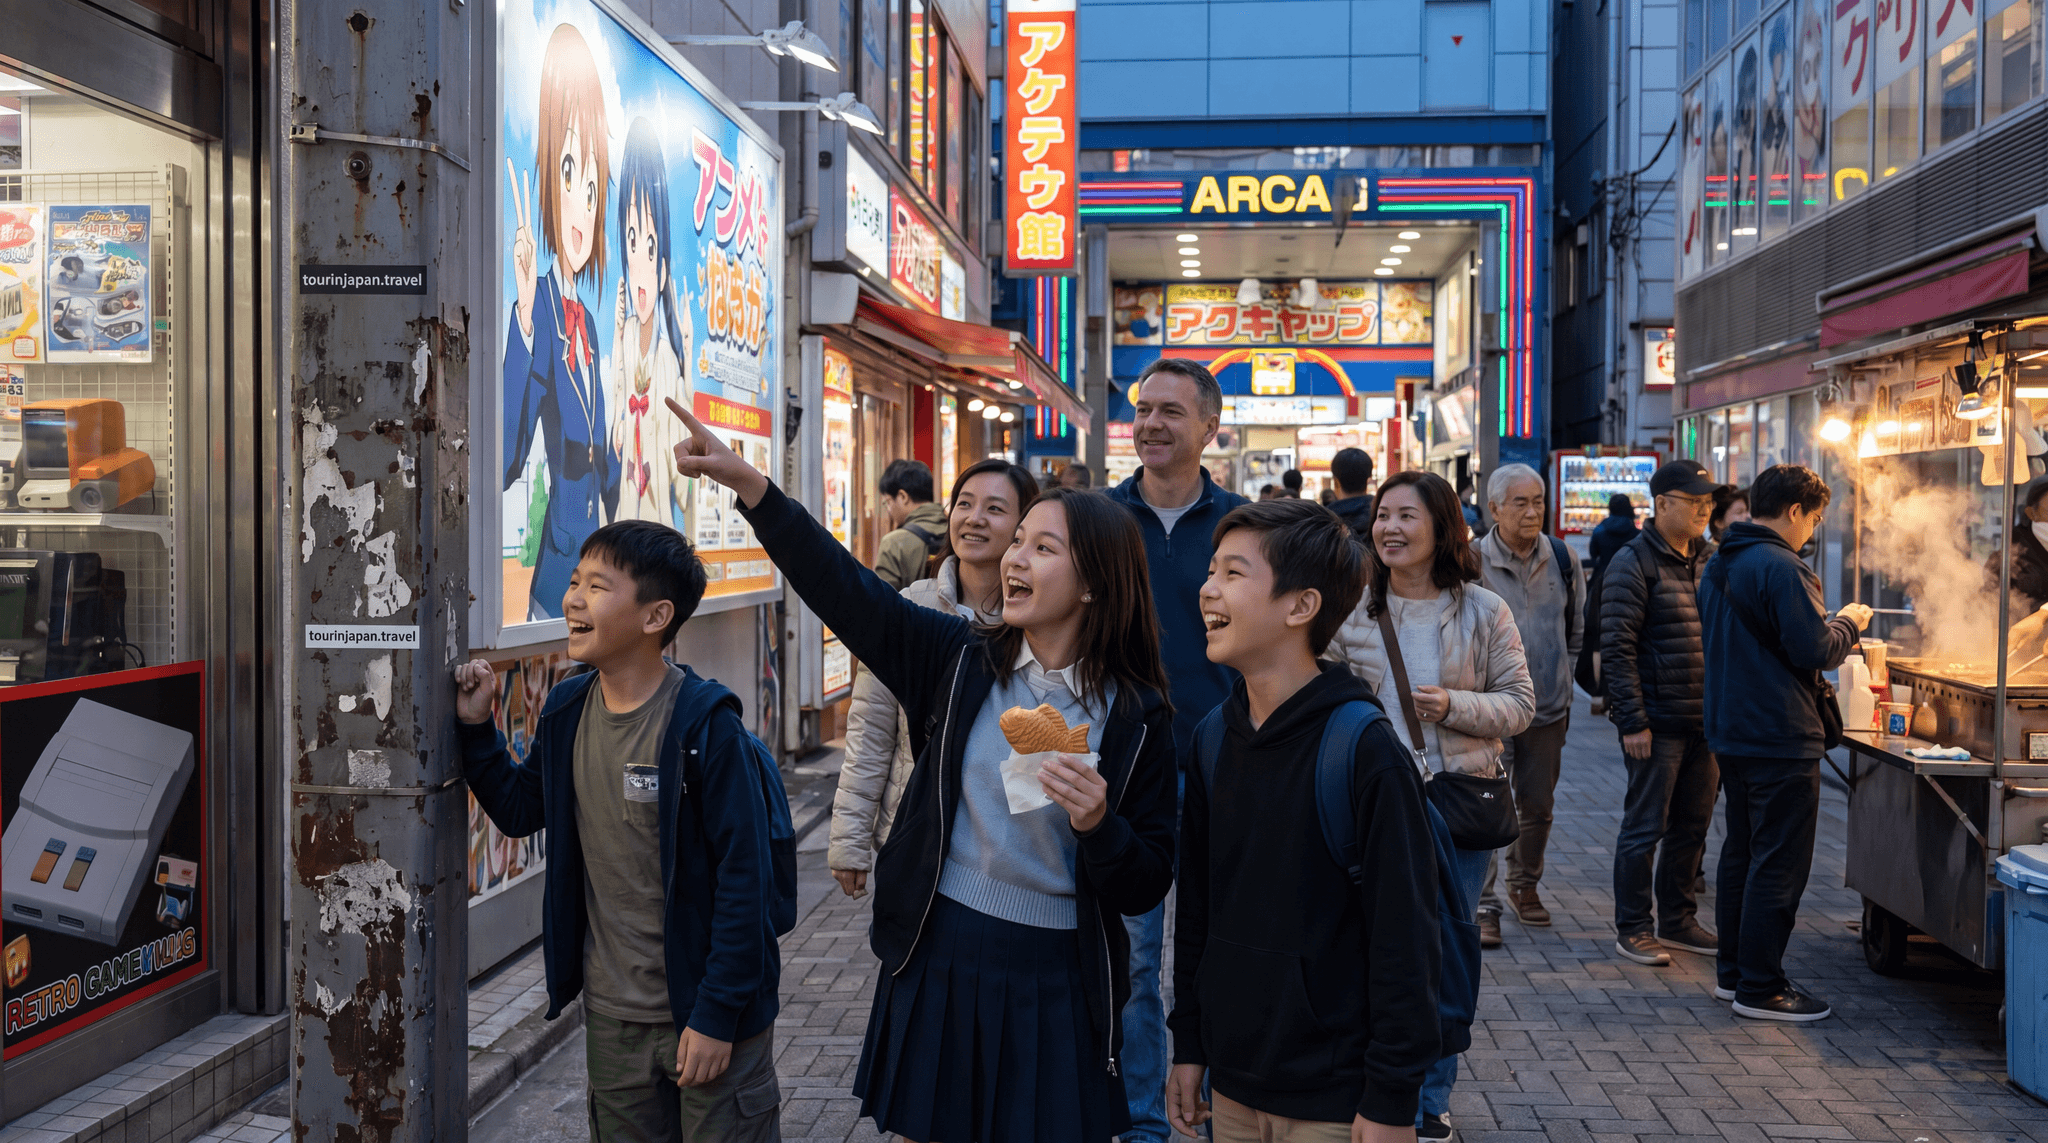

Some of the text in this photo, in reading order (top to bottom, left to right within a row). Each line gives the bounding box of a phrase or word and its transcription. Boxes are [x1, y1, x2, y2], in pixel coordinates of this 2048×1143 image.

[303, 273, 422, 289] tourinjapan.travel
[309, 630, 416, 644] tourinjapan.travel
[6, 974, 81, 1035] RETRO
